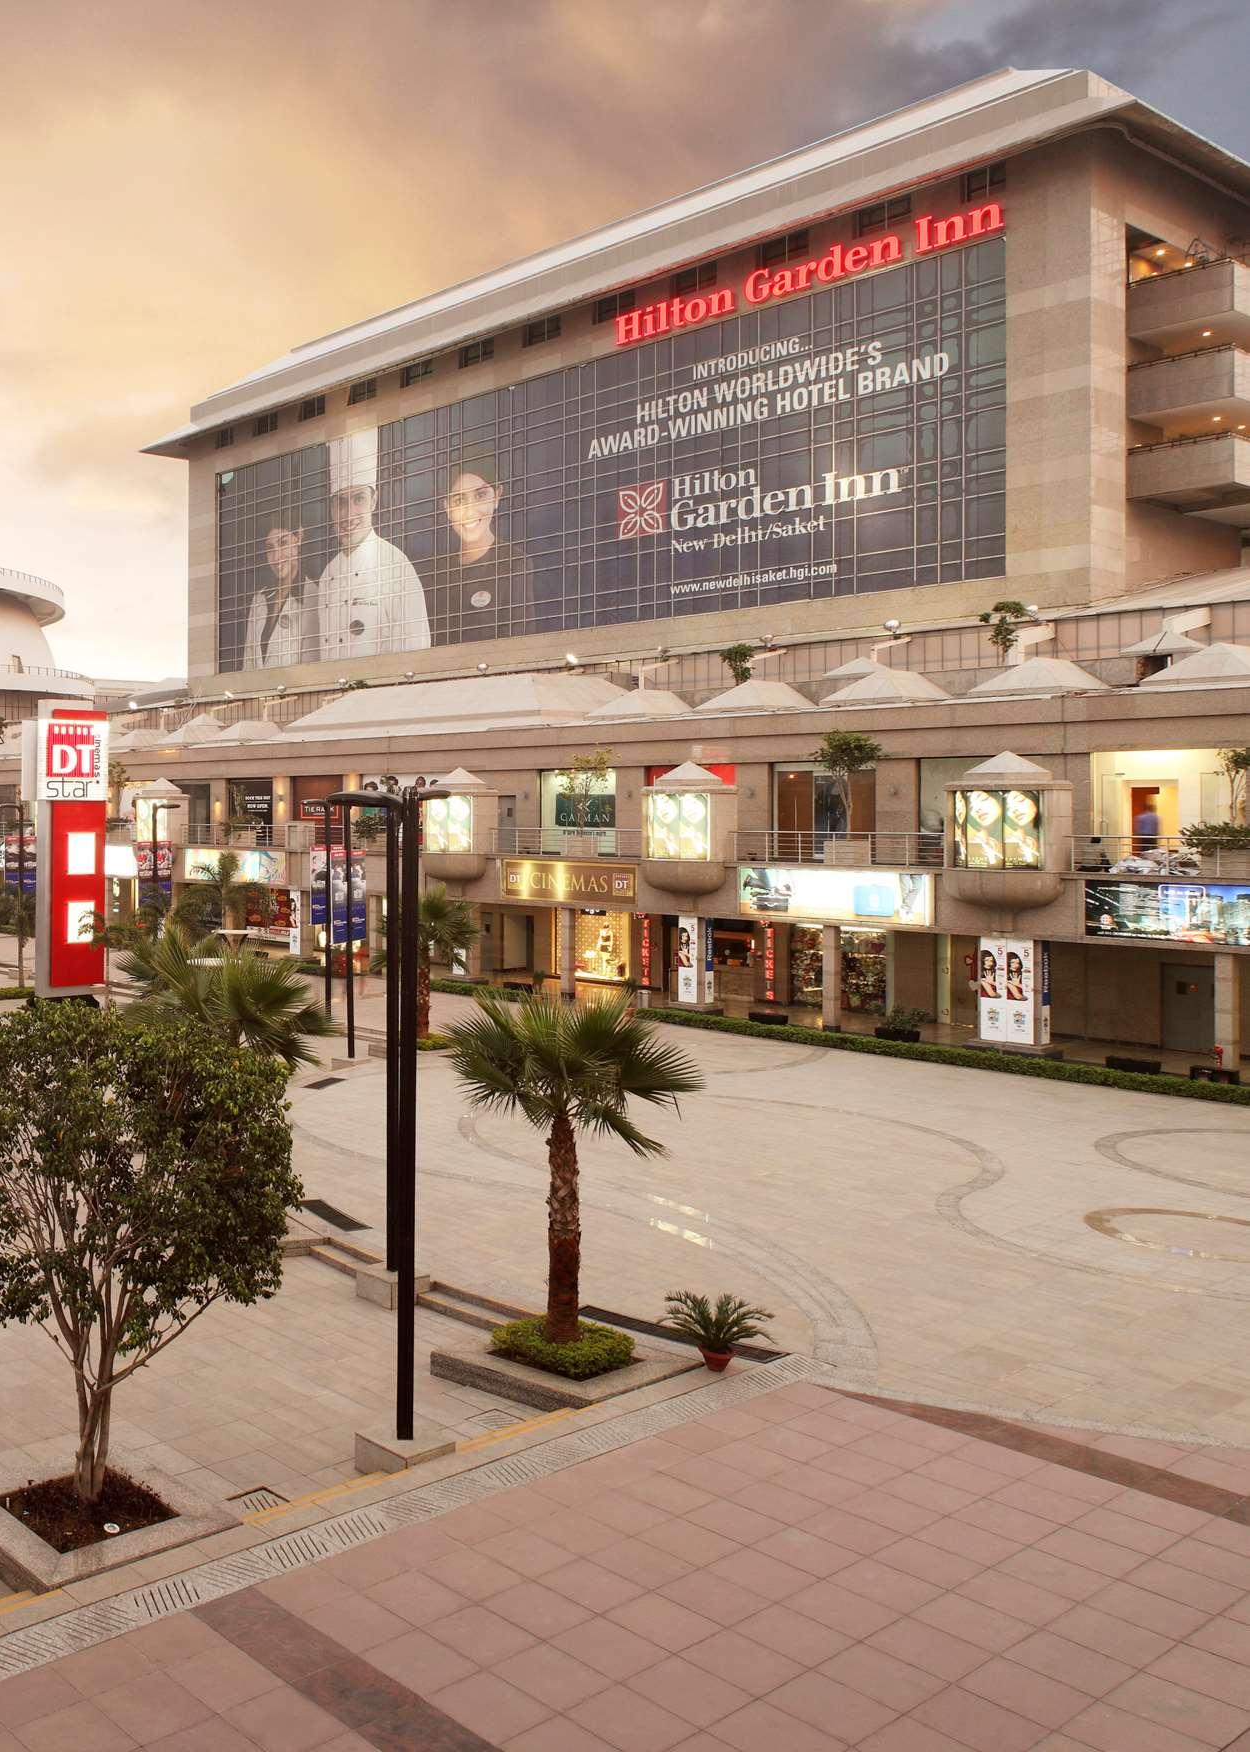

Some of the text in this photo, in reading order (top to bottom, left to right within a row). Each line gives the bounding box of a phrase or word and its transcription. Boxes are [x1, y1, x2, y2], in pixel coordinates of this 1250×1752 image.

[615, 203, 1004, 345] Hilton Garden Inn
[692, 337, 813, 380] INTRODUCING...
[636, 341, 882, 424] HILTON WORLDWIDE'S
[588, 352, 949, 460] AWARD-WINNING HOTEL BRAND
[670, 468, 902, 531] Garden Inn
[672, 468, 757, 500] Hilton
[671, 514, 827, 555] New Delhi/Saket
[670, 563, 838, 594] www.newdelhisaket.hgi.com
[51, 744, 95, 774] DT
[46, 776, 93, 798] star
[304, 805, 335, 813] TIE RAK
[530, 872, 608, 893] CINEMAS
[615, 880, 629, 889] DT
[642, 918, 650, 986] TICKETS
[765, 928, 775, 1000] TICKETS
[997, 947, 1003, 956] 5
[1023, 949, 1030, 958] 5
